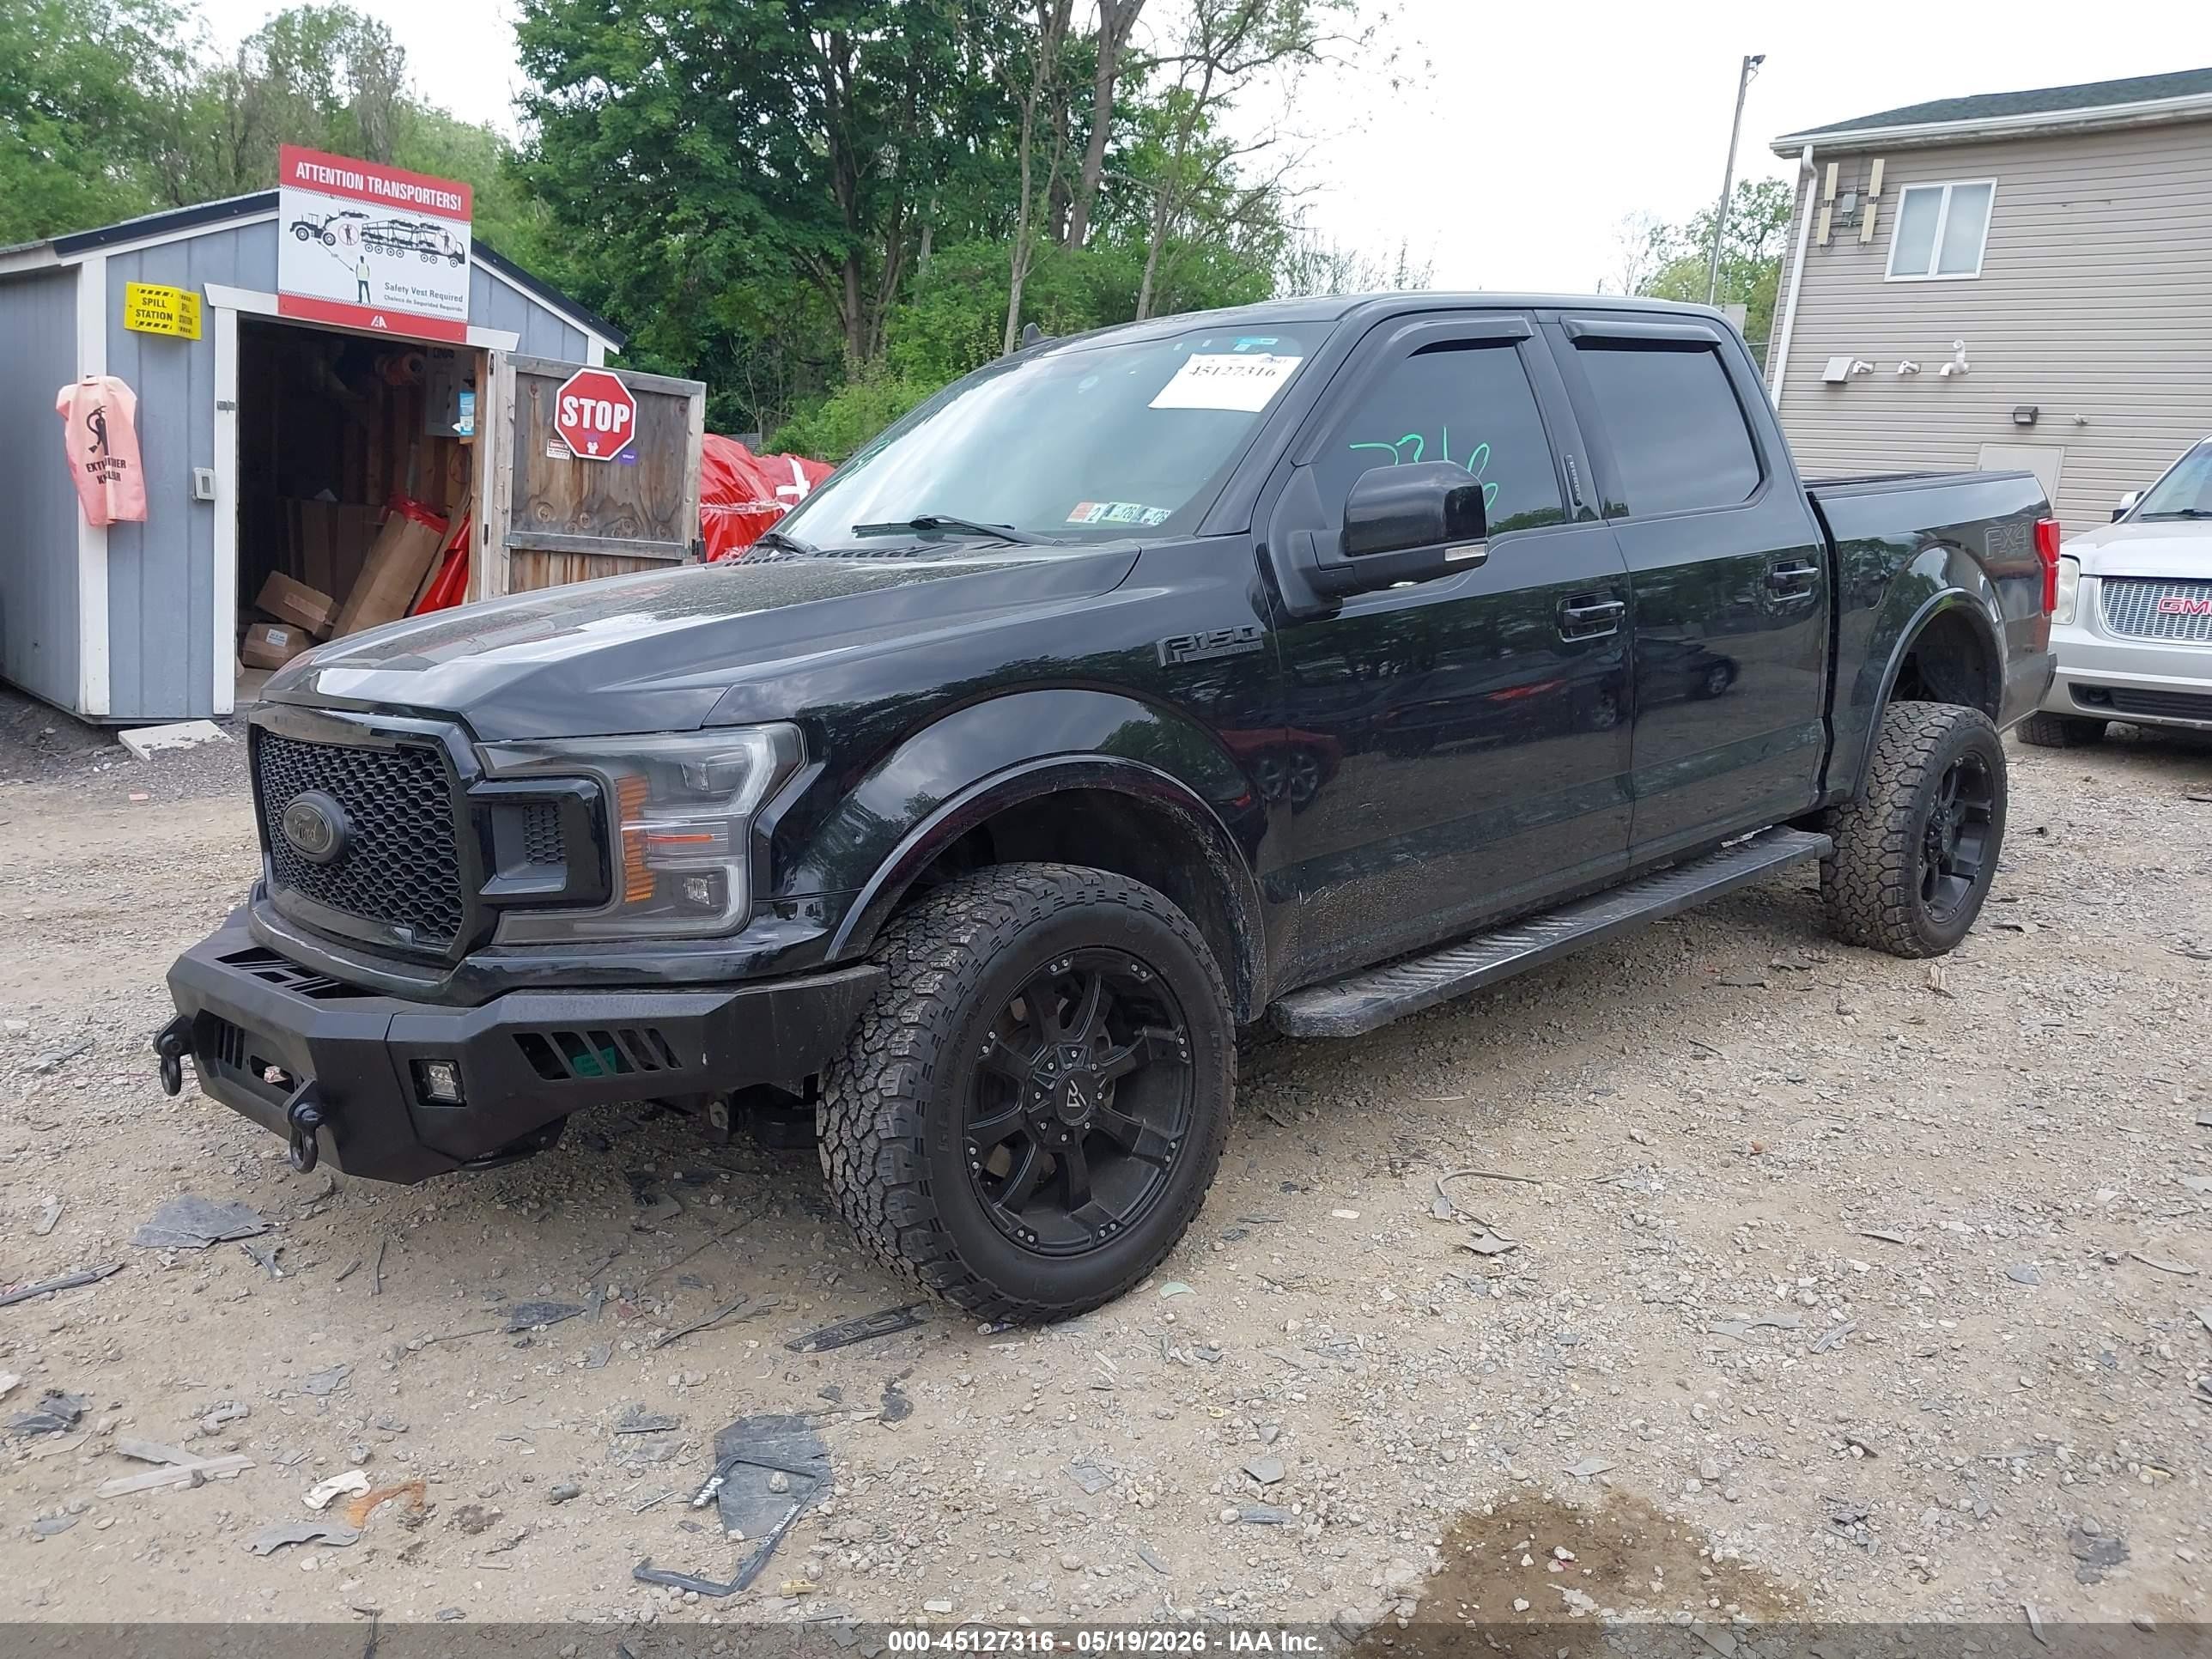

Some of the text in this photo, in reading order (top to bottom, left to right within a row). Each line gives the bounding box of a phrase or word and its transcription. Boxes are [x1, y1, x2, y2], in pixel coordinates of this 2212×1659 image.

[295, 161, 462, 211] ATTENTION TRANSPORTERS!
[142, 296, 167, 308] SPILL
[385, 282, 463, 303] Safety Vest Required
[135, 308, 173, 321] STATION
[561, 395, 630, 434] STOP
[1984, 522, 2030, 559] FX4
[2158, 597, 2212, 615] GM
[693, 1477, 724, 1505] Drive
